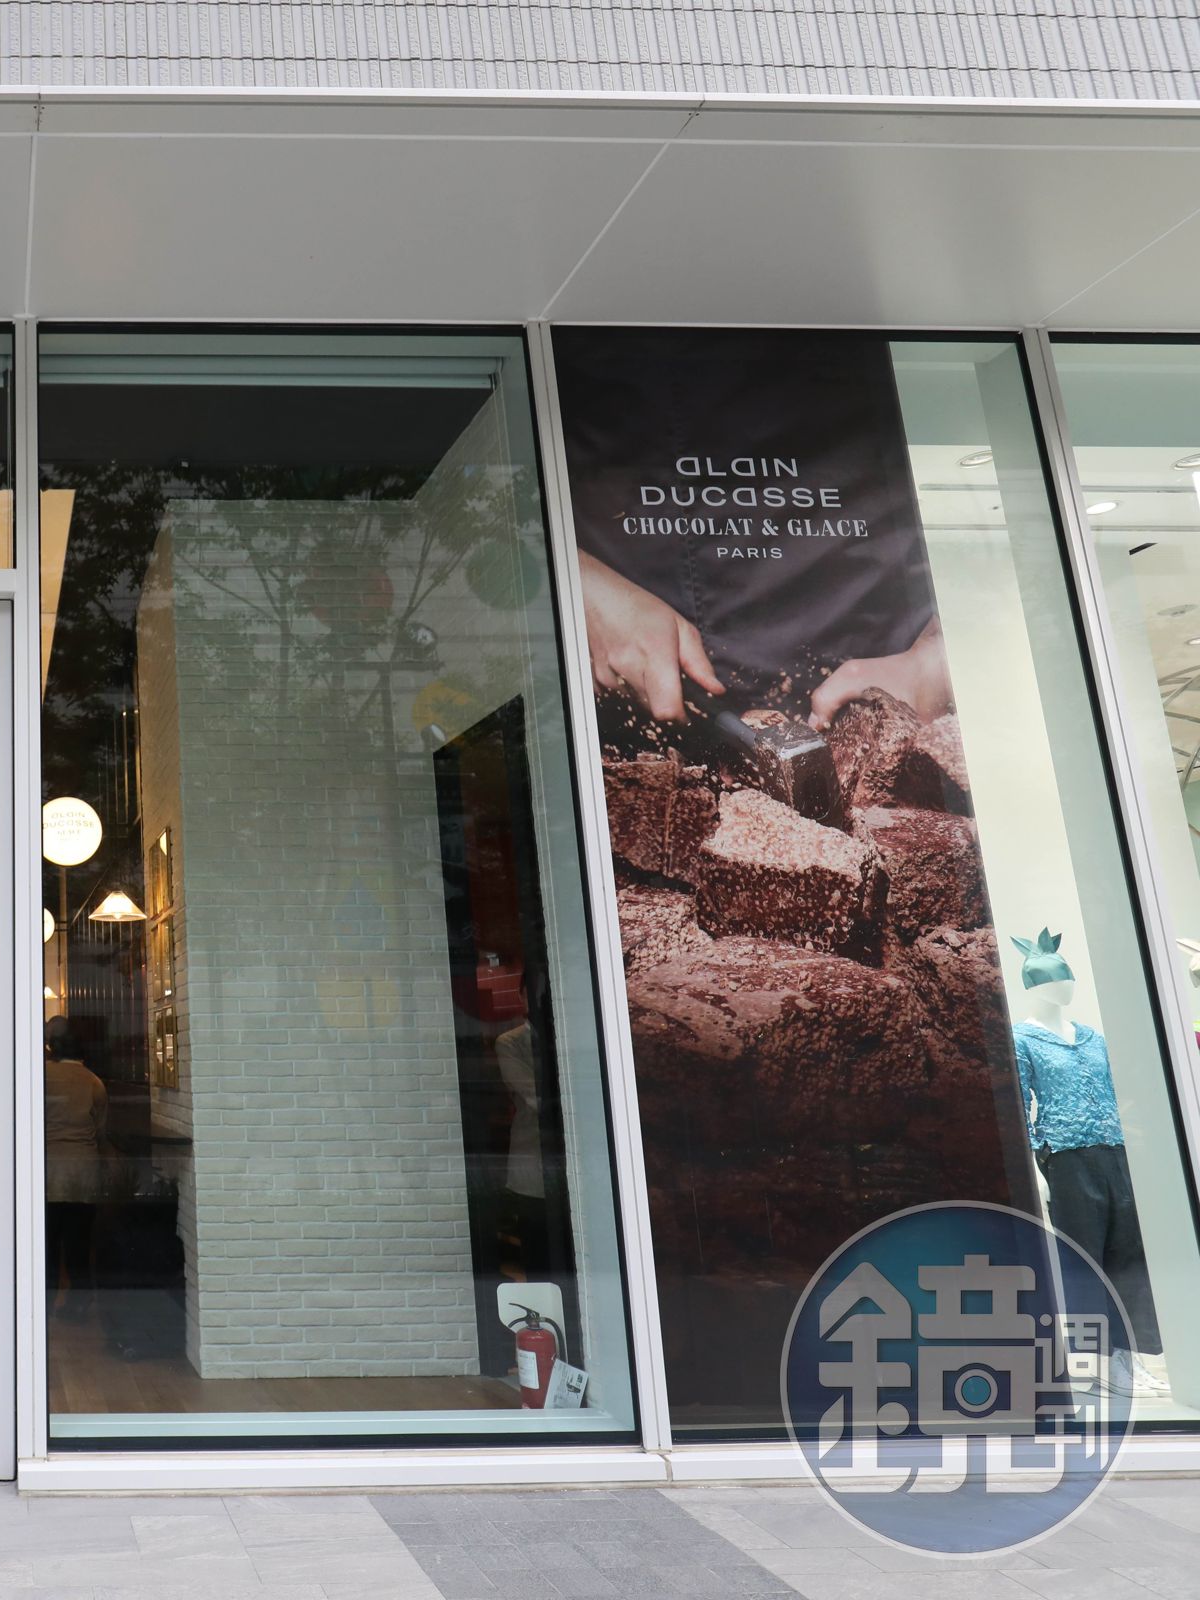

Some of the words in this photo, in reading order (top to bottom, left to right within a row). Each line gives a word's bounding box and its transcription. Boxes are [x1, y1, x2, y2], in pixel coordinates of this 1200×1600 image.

[675, 456, 799, 477] ALAIN
[640, 485, 842, 508] DUCASSE
[622, 516, 753, 537] CHOCOLAT
[761, 519, 779, 537] &
[787, 518, 869, 538] GLACE
[716, 546, 783, 559] PARIS
